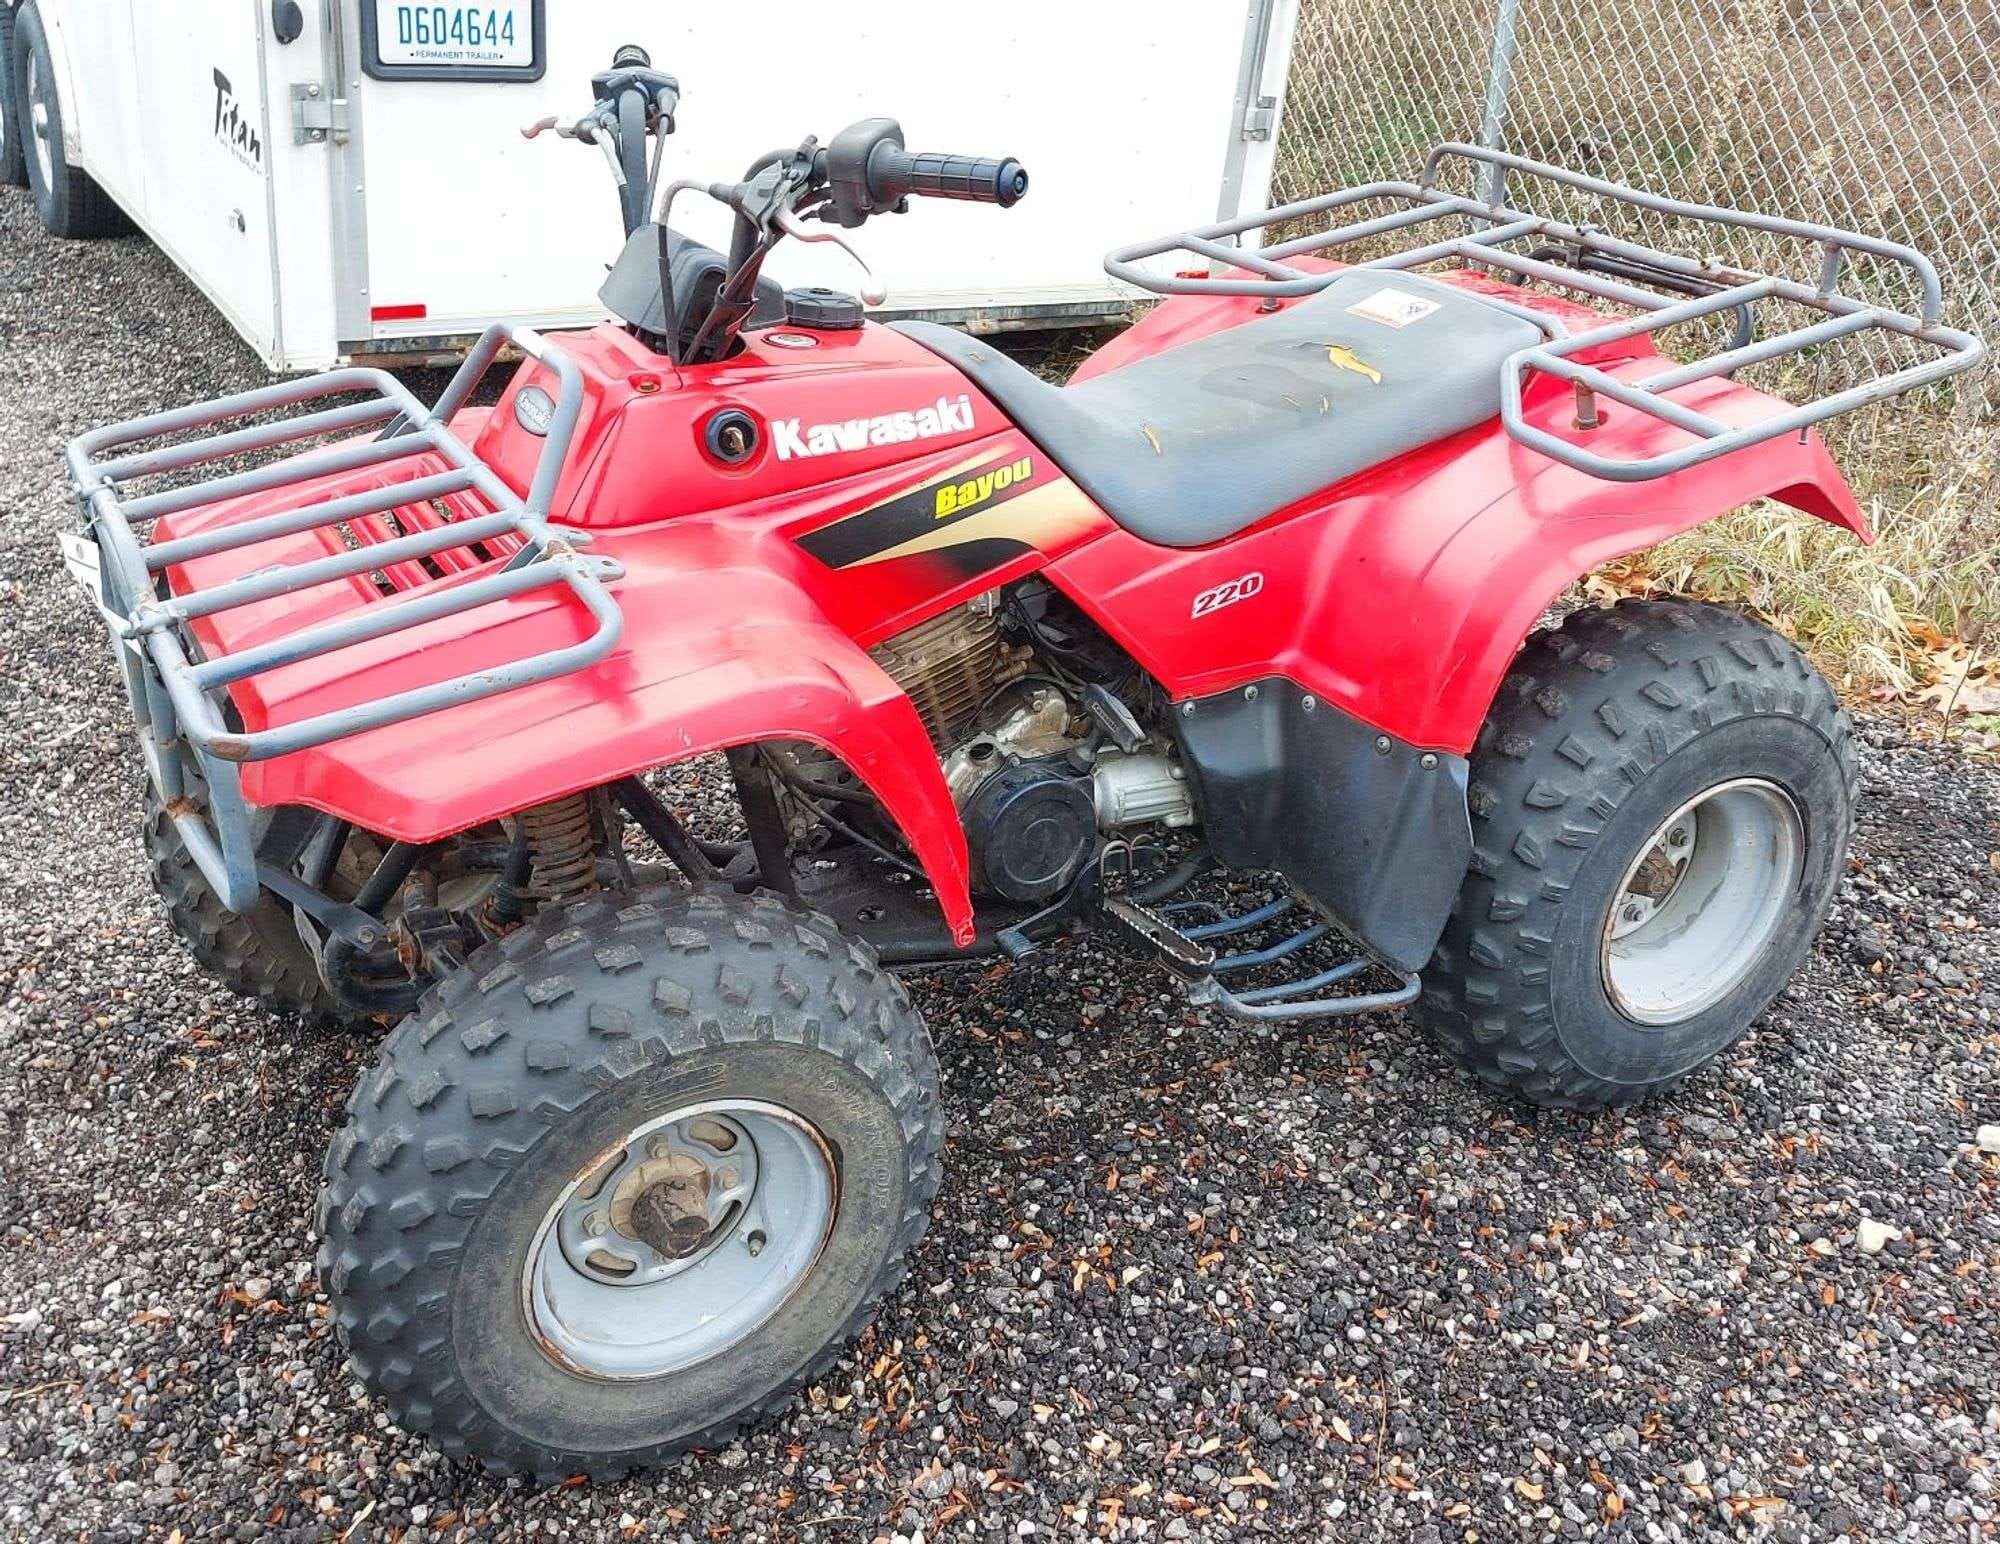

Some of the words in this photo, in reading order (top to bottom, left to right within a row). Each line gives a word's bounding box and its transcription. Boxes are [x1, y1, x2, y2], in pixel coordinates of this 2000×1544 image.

[398, 6, 514, 46] D604644
[415, 51, 463, 60] PERMANENT
[466, 51, 498, 60] TRAILER
[213, 66, 261, 163] Titan
[771, 394, 976, 462] Kawasaki
[934, 456, 1033, 519] Bayou
[1190, 571, 1264, 619] 220
